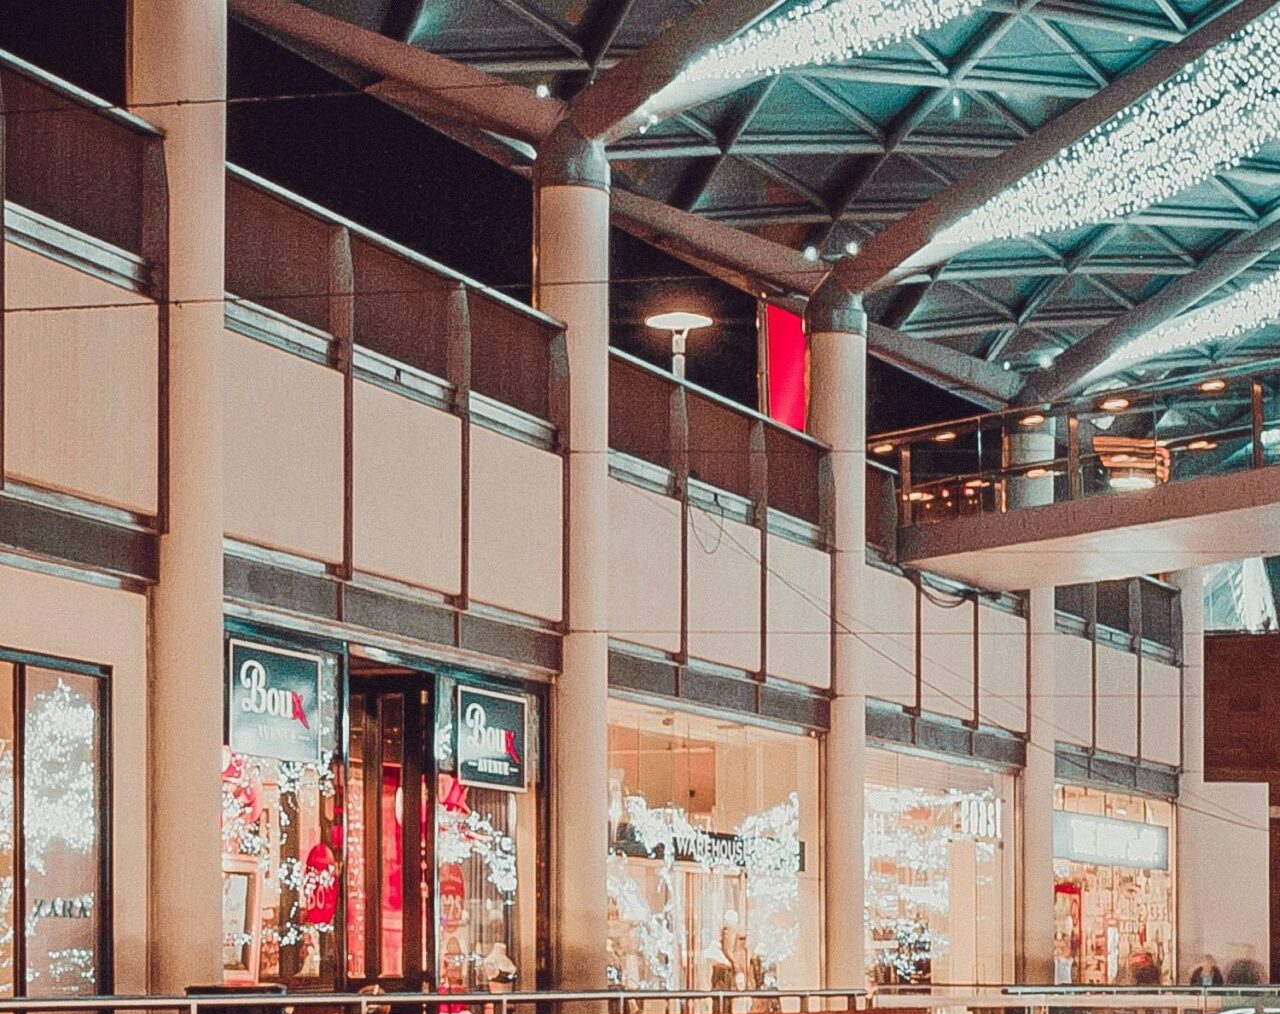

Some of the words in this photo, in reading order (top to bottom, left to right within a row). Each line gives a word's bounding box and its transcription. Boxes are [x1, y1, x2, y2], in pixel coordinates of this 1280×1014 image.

[240, 659, 310, 731] Boux
[465, 702, 520, 765] Boux
[477, 758, 510, 776] AVENUE
[33, 897, 90, 918] ZARA
